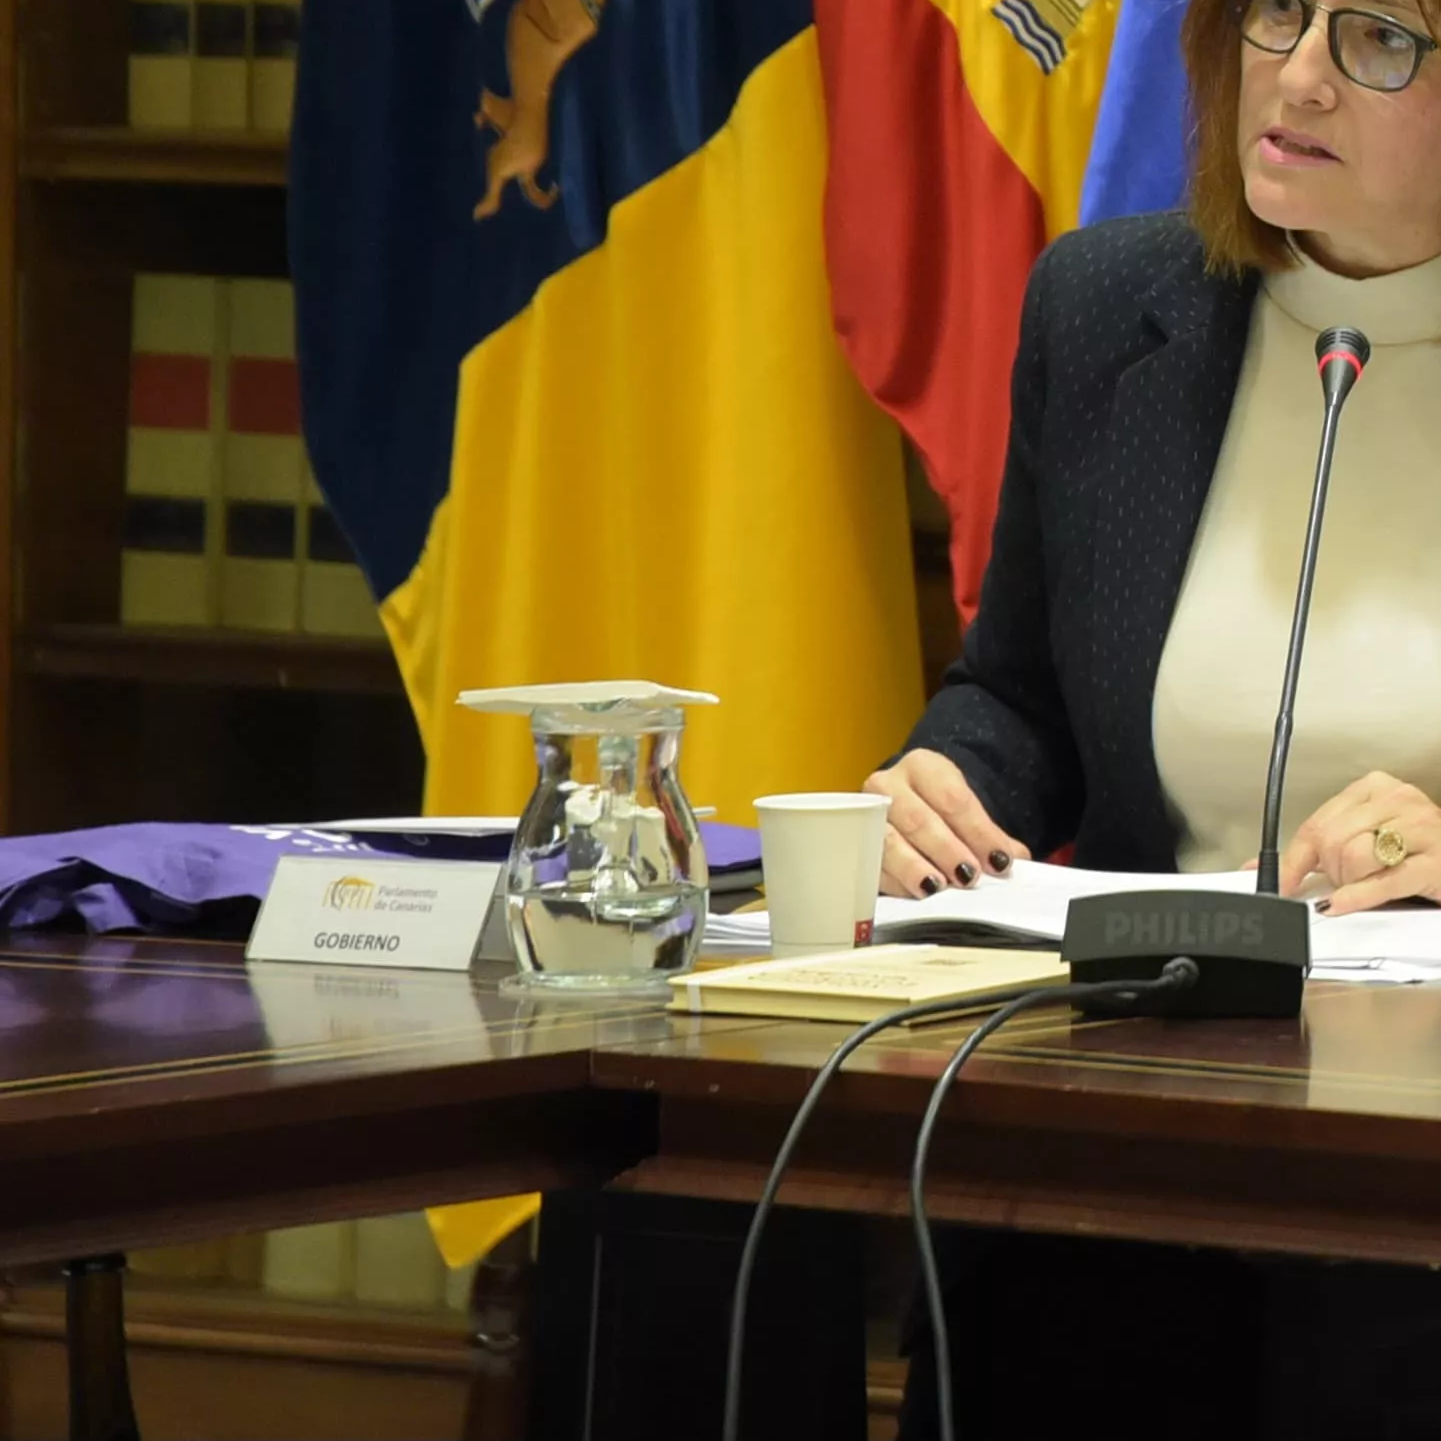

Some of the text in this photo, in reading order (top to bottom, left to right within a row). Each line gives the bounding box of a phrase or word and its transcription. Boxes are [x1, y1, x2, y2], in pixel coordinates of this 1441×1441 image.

[377, 885, 438, 900] Parlamento
[374, 900, 433, 914] de Canarias
[1103, 910, 1265, 947] PHILIPS
[313, 931, 400, 953] GOBIERNO
